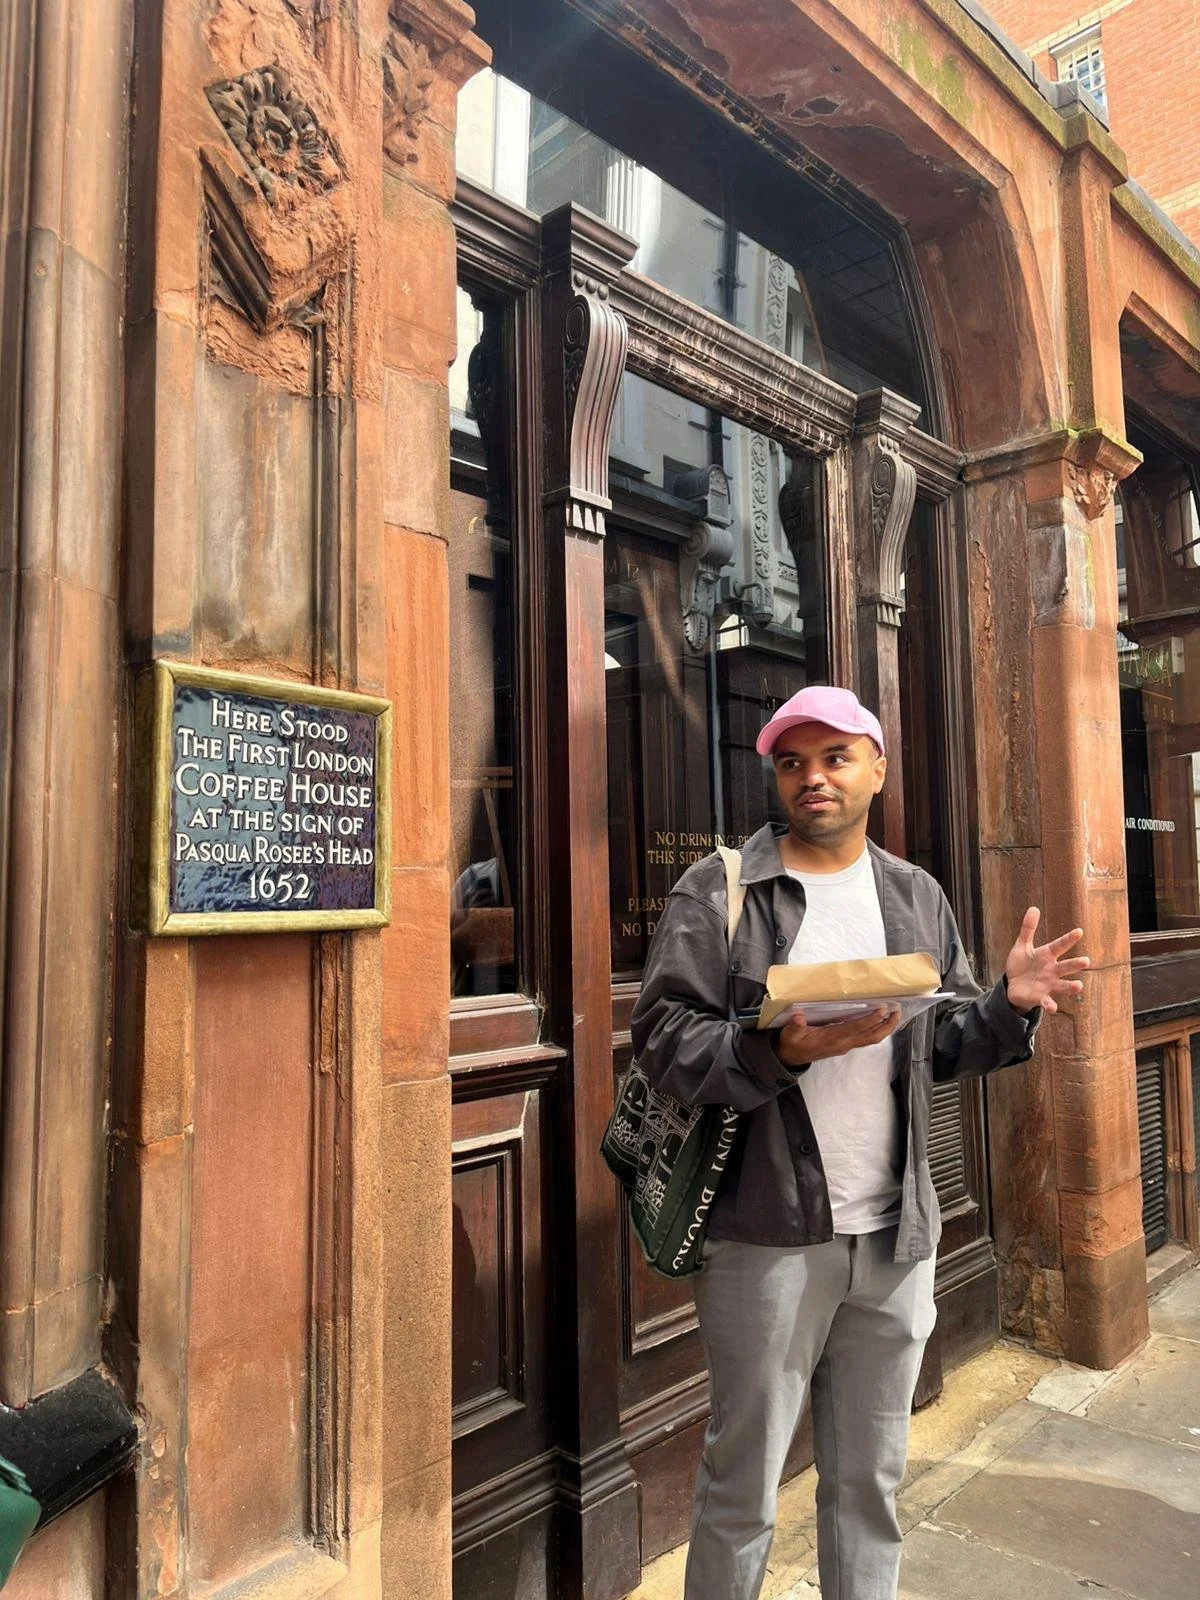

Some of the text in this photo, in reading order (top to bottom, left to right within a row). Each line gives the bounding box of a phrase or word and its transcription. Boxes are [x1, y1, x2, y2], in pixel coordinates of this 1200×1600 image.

[211, 698, 348, 743] HERE STOOD
[177, 727, 374, 777] THE FIRST LONDON
[175, 762, 372, 809] COFFEE HOUSE
[189, 807, 365, 836] AT THE SIGN OF
[1125, 817, 1176, 832] AIR CONDITIONED
[174, 833, 374, 866] PASQUA ROSEE'S HEAD
[656, 831, 676, 847] NO
[647, 850, 675, 864] THIS
[249, 867, 311, 903] 1652
[622, 923, 642, 937] NO
